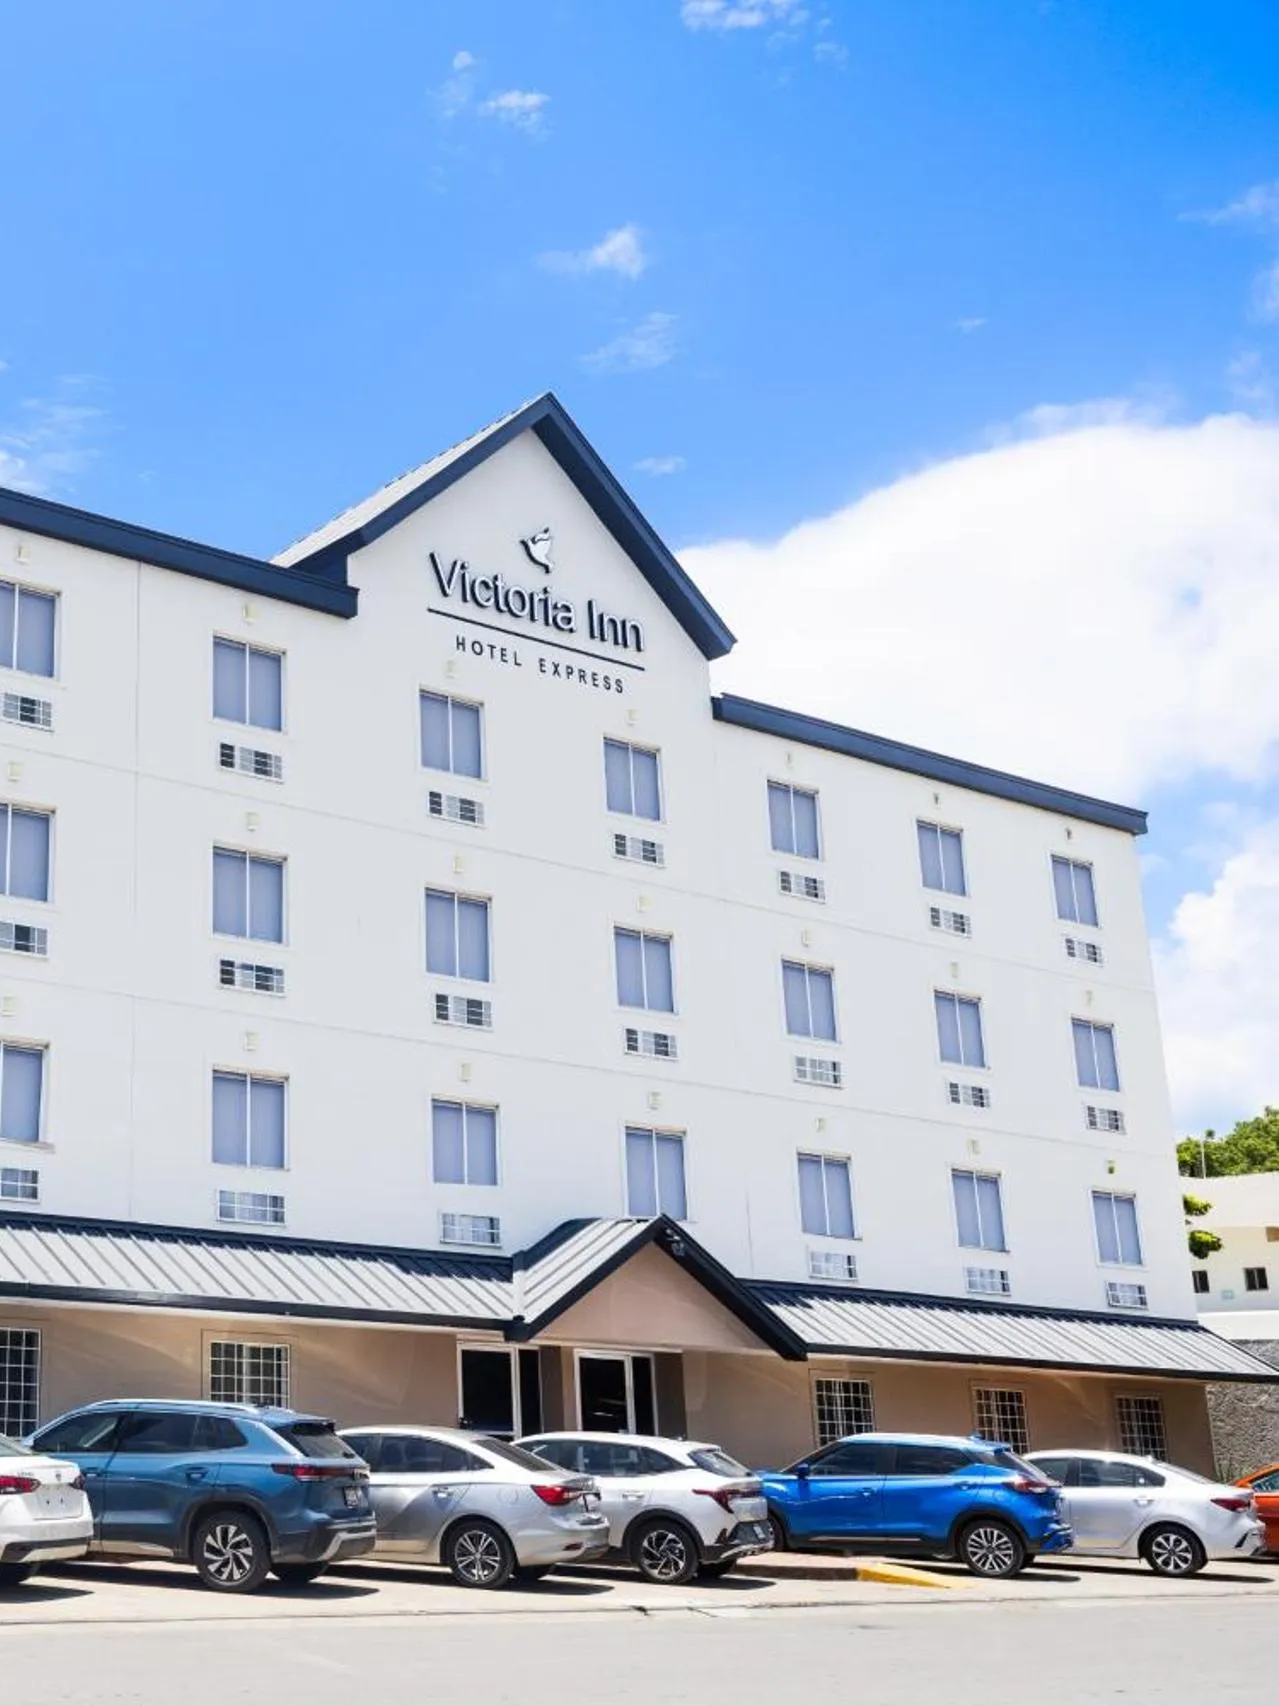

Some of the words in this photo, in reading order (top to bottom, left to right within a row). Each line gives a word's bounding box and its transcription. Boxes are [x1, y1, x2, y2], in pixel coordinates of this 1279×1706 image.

[429, 551, 577, 633] Victoria
[587, 599, 645, 653] Inn
[455, 635, 523, 667] HOTEL
[538, 658, 625, 694] EXPRESS
